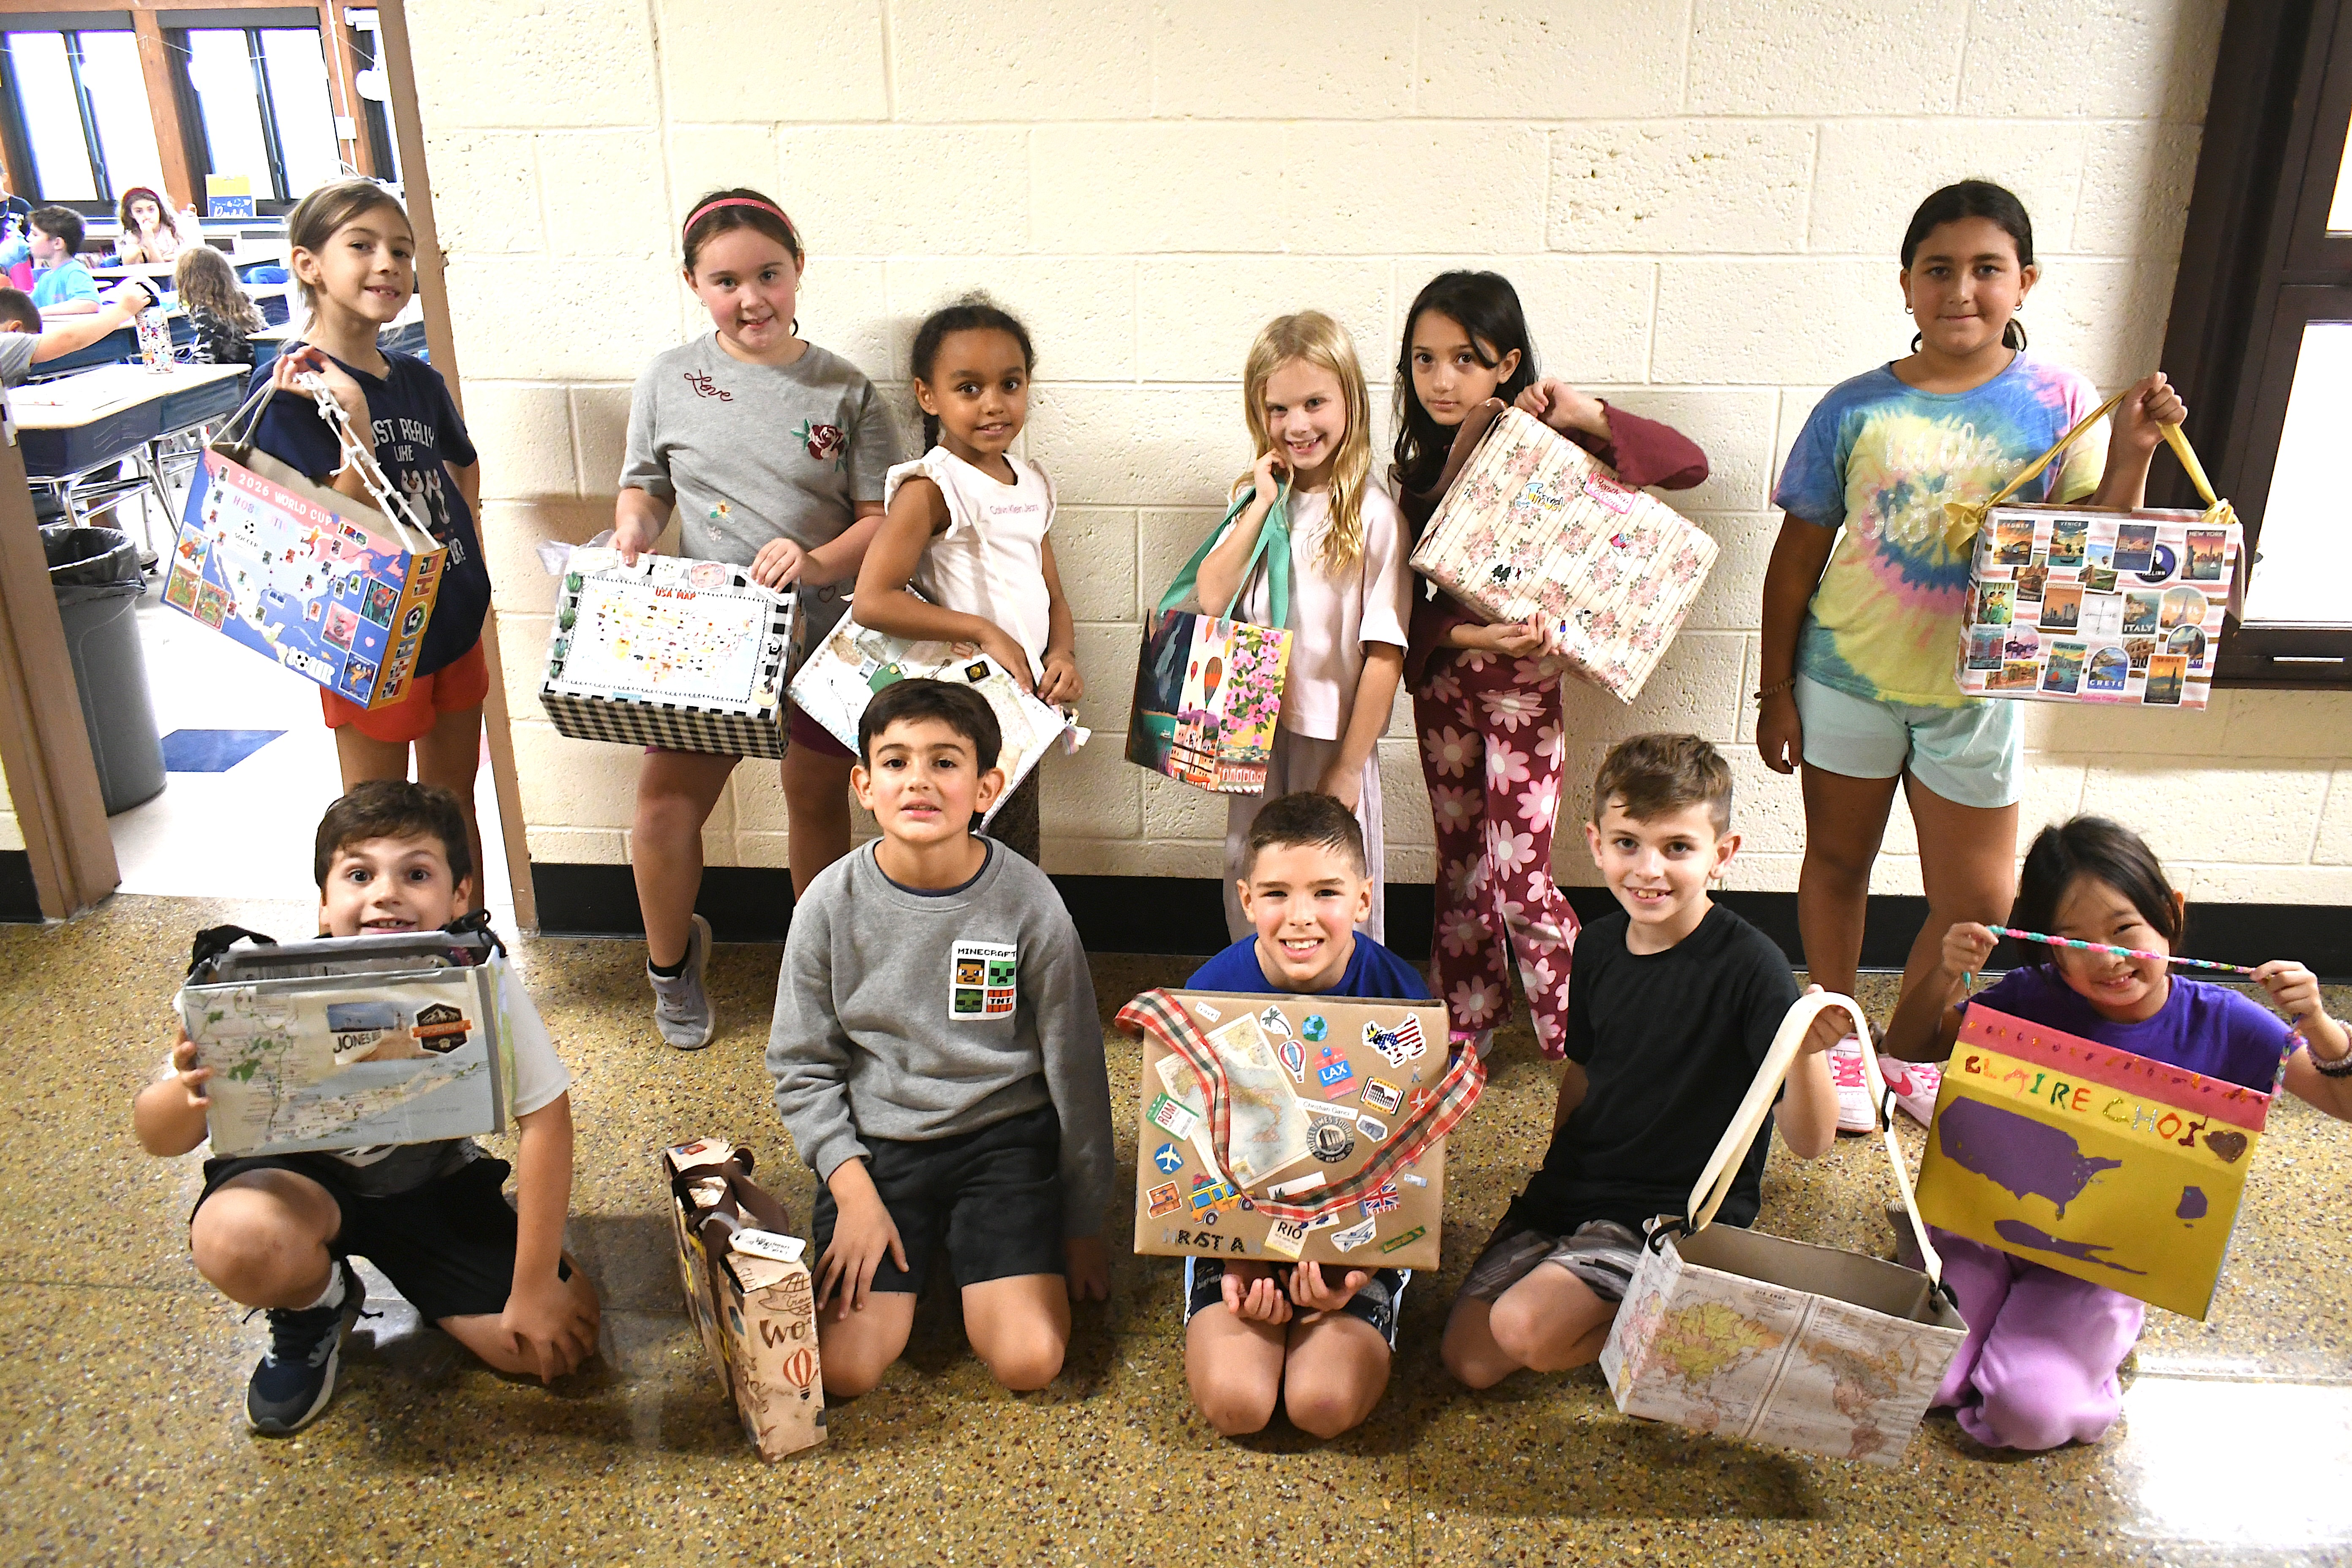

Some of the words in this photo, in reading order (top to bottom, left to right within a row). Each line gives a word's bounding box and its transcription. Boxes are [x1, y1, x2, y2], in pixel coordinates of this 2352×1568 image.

[399, 417, 435, 449] REALLY
[394, 444, 414, 462] LIKE
[239, 474, 269, 496] 2026
[275, 492, 307, 515] WORLD
[310, 509, 332, 526] CUP
[1525, 482, 1563, 512] Travel
[655, 588, 672, 598] USA
[676, 591, 697, 600] MAP
[2124, 624, 2154, 632] ITALY
[957, 948, 1017, 958] MINECRAFT
[333, 1033, 372, 1054] JONES
[1321, 1062, 1348, 1081] LAX
[1965, 1056, 2091, 1113] CLAIRE
[1157, 1102, 1177, 1125] ROM
[1303, 1101, 1330, 1112] Christian
[1311, 1115, 1333, 1130] TIMES
[1335, 1116, 1354, 1141] SQUARE
[1307, 1130, 1317, 1153] HOTEL
[1367, 1204, 1401, 1217] LONDON
[1277, 1221, 1302, 1239] RIO
